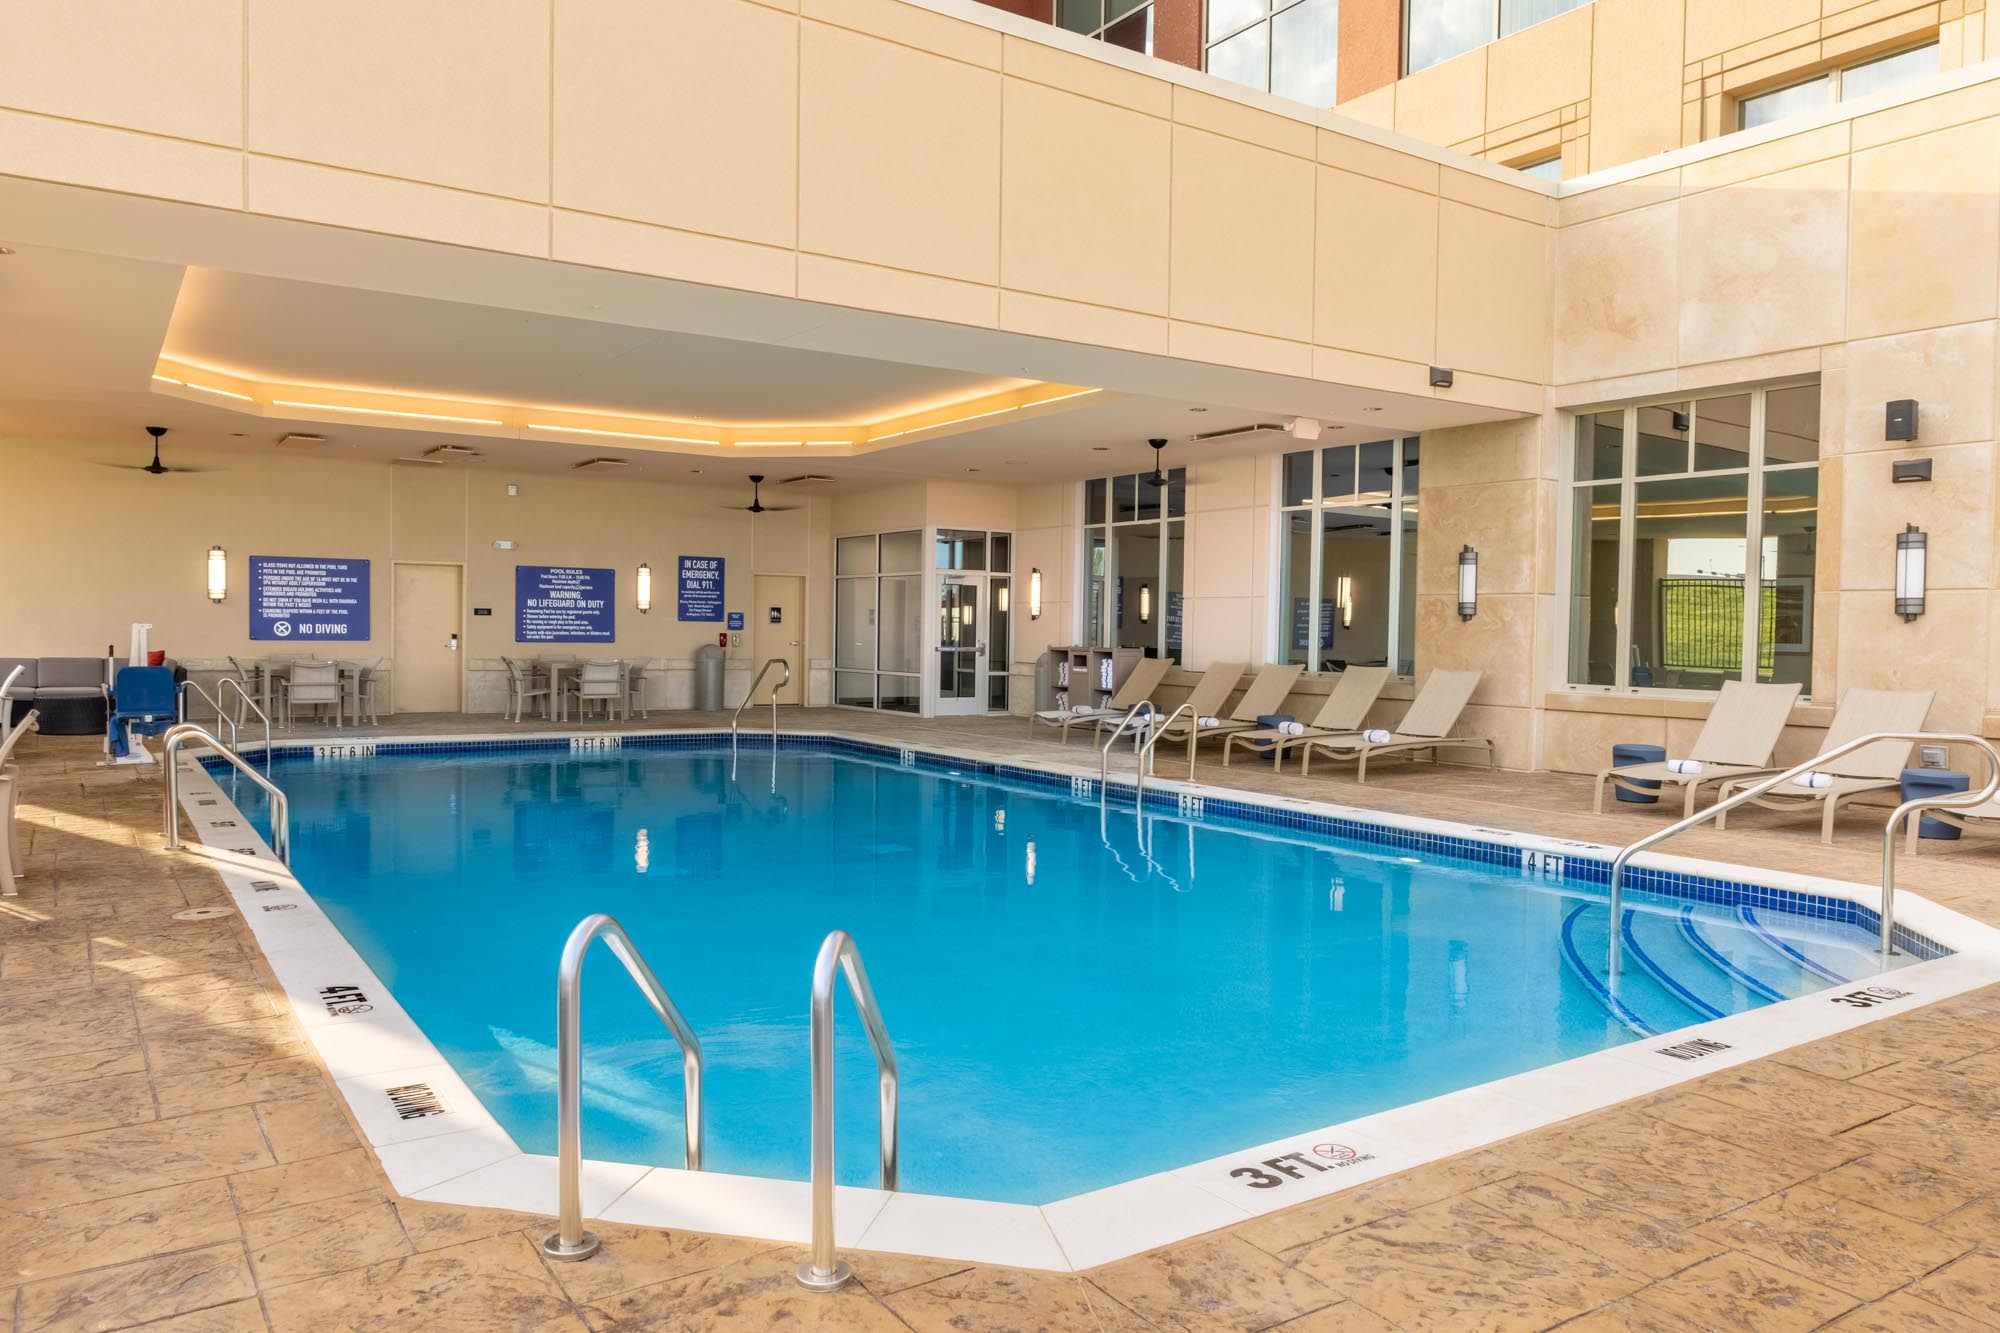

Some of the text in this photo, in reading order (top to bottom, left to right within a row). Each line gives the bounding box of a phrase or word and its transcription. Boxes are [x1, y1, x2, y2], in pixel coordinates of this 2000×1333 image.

[684, 560, 718, 570] IN CASE OF
[682, 570, 720, 580] EMERGENCY,
[686, 580, 715, 590] DIAL 911.
[539, 599, 575, 607] LIFEGUARD
[299, 624, 347, 634] NO DIVING
[574, 737, 620, 750] 3 FT 6 IN
[319, 745, 374, 758] 3 FT 6 IN
[1183, 796, 1187, 810] 5
[1528, 852, 1562, 874] 4 FT
